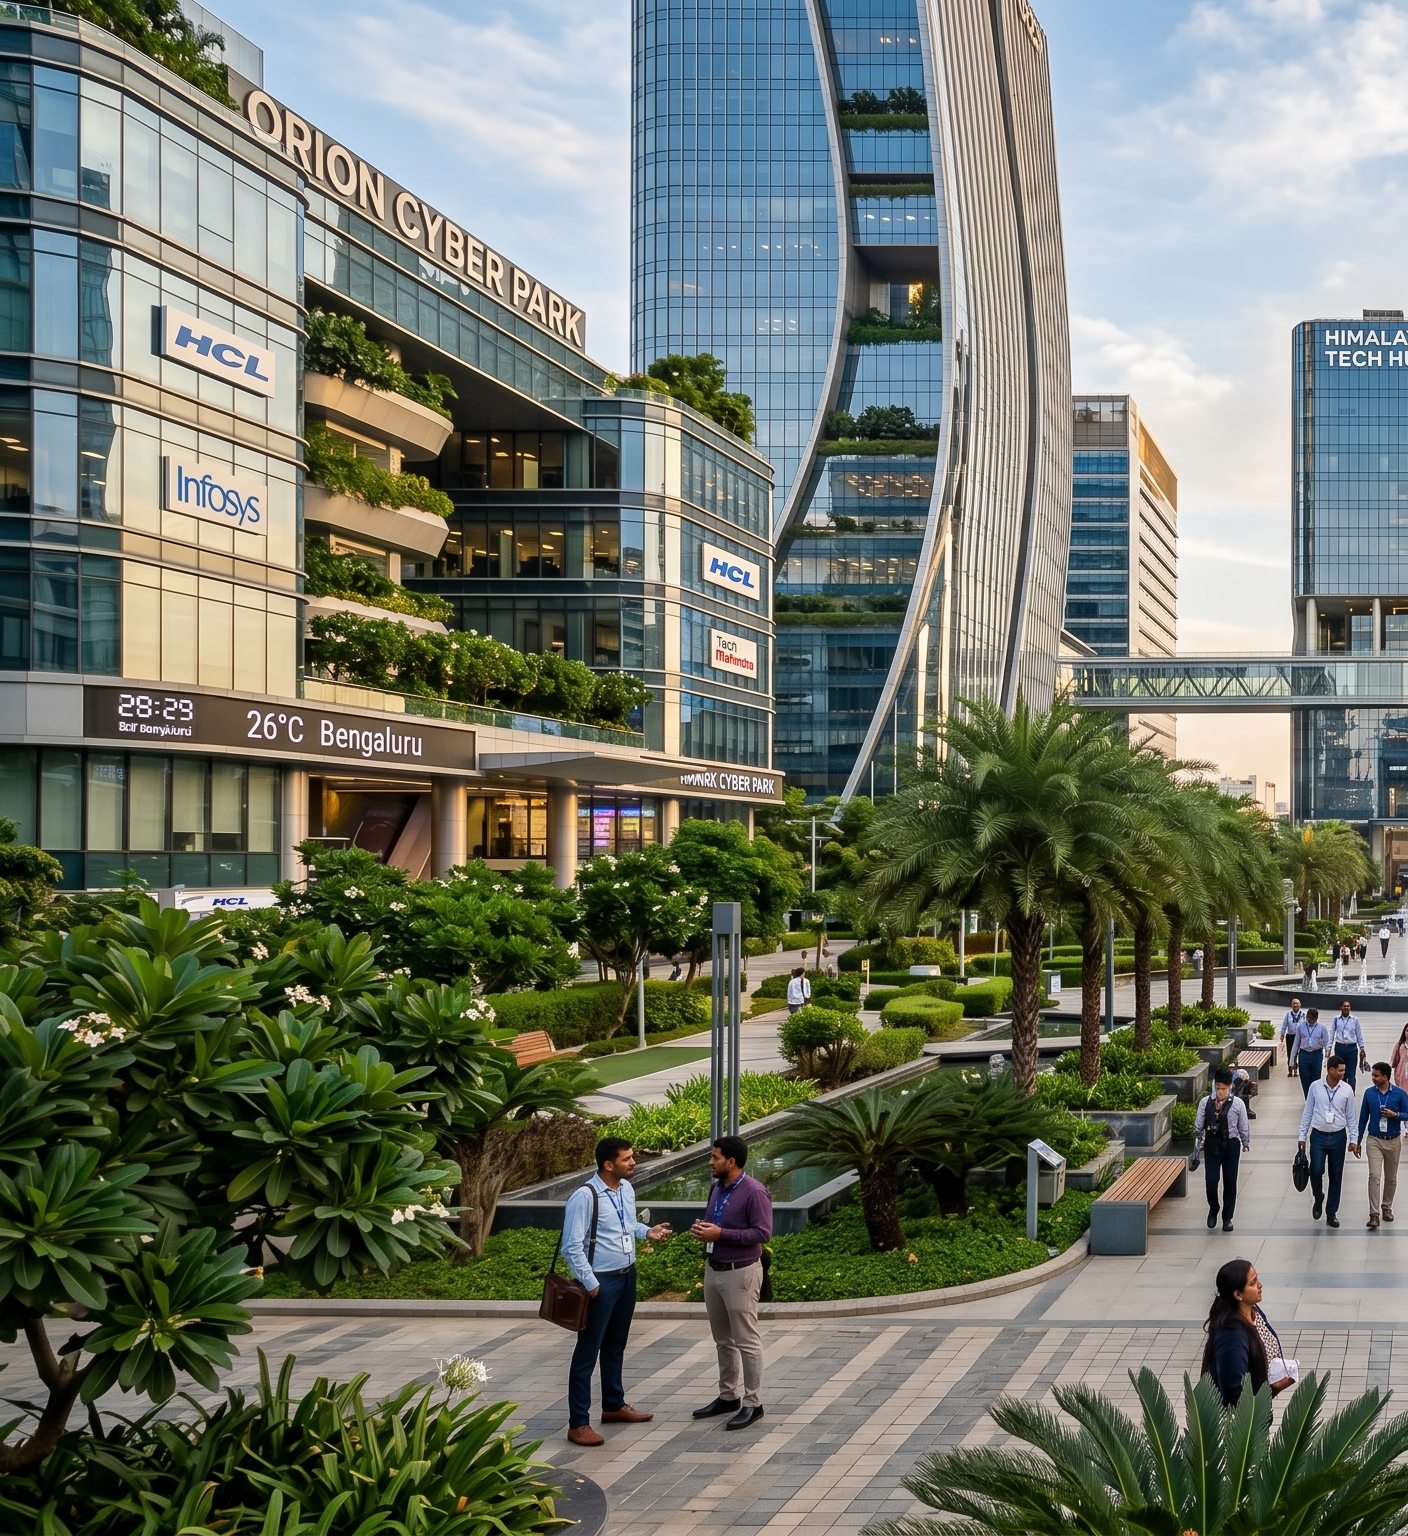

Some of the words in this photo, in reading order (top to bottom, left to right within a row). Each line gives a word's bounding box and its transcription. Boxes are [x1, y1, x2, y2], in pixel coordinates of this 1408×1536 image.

[247, 90, 385, 221] ORION
[394, 191, 504, 297] CYBER
[512, 265, 582, 348] PARK
[174, 324, 269, 383] HCL
[1324, 350, 1382, 367] TECH
[177, 464, 261, 526] Infosys
[709, 557, 755, 589] HCL
[246, 709, 305, 743] 26°C
[320, 719, 423, 757] Bengaluru
[719, 773, 751, 792] CYBER
[752, 777, 775, 795] PARK
[212, 897, 249, 907] HCL
